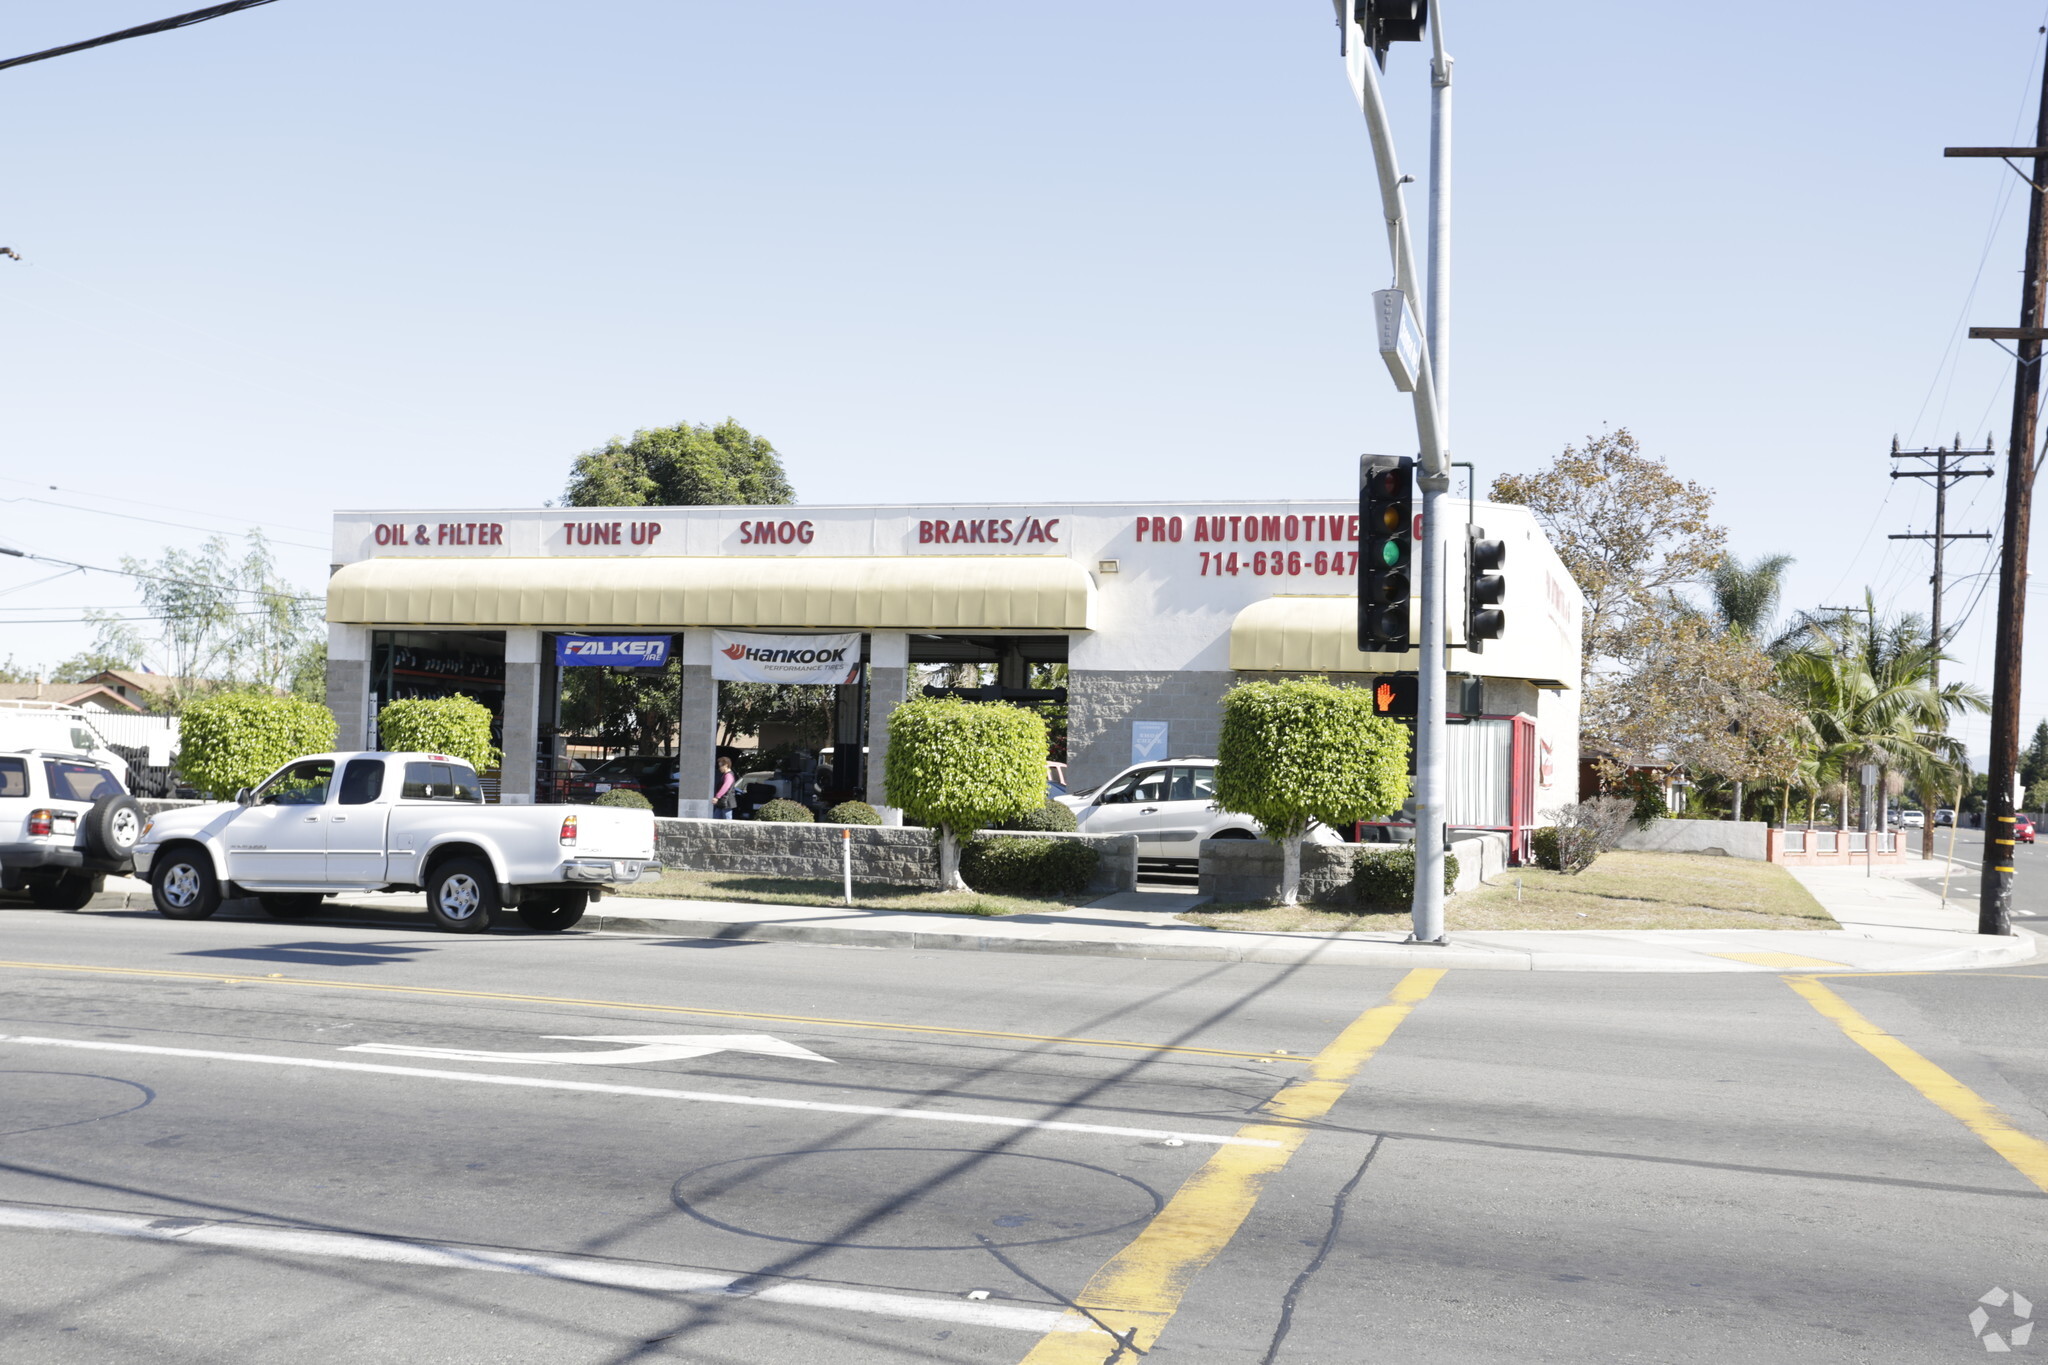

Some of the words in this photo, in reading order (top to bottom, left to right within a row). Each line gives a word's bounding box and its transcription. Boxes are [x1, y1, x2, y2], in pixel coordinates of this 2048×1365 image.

[374, 523, 408, 546] OIL
[415, 524, 430, 545] &
[437, 523, 503, 546] FILTER
[563, 522, 622, 546] TUNE
[629, 522, 661, 545] UP
[740, 521, 815, 545] SMOG
[919, 517, 1059, 545] BRAKES/AC
[1136, 516, 1183, 544] PRO
[1193, 514, 1359, 543] AUTOMOTIVE
[1199, 550, 1359, 578] 714-636-647
[564, 641, 664, 655] FALKEN
[764, 664, 822, 672] PERFORMANCE
[824, 663, 844, 671] TIRES
